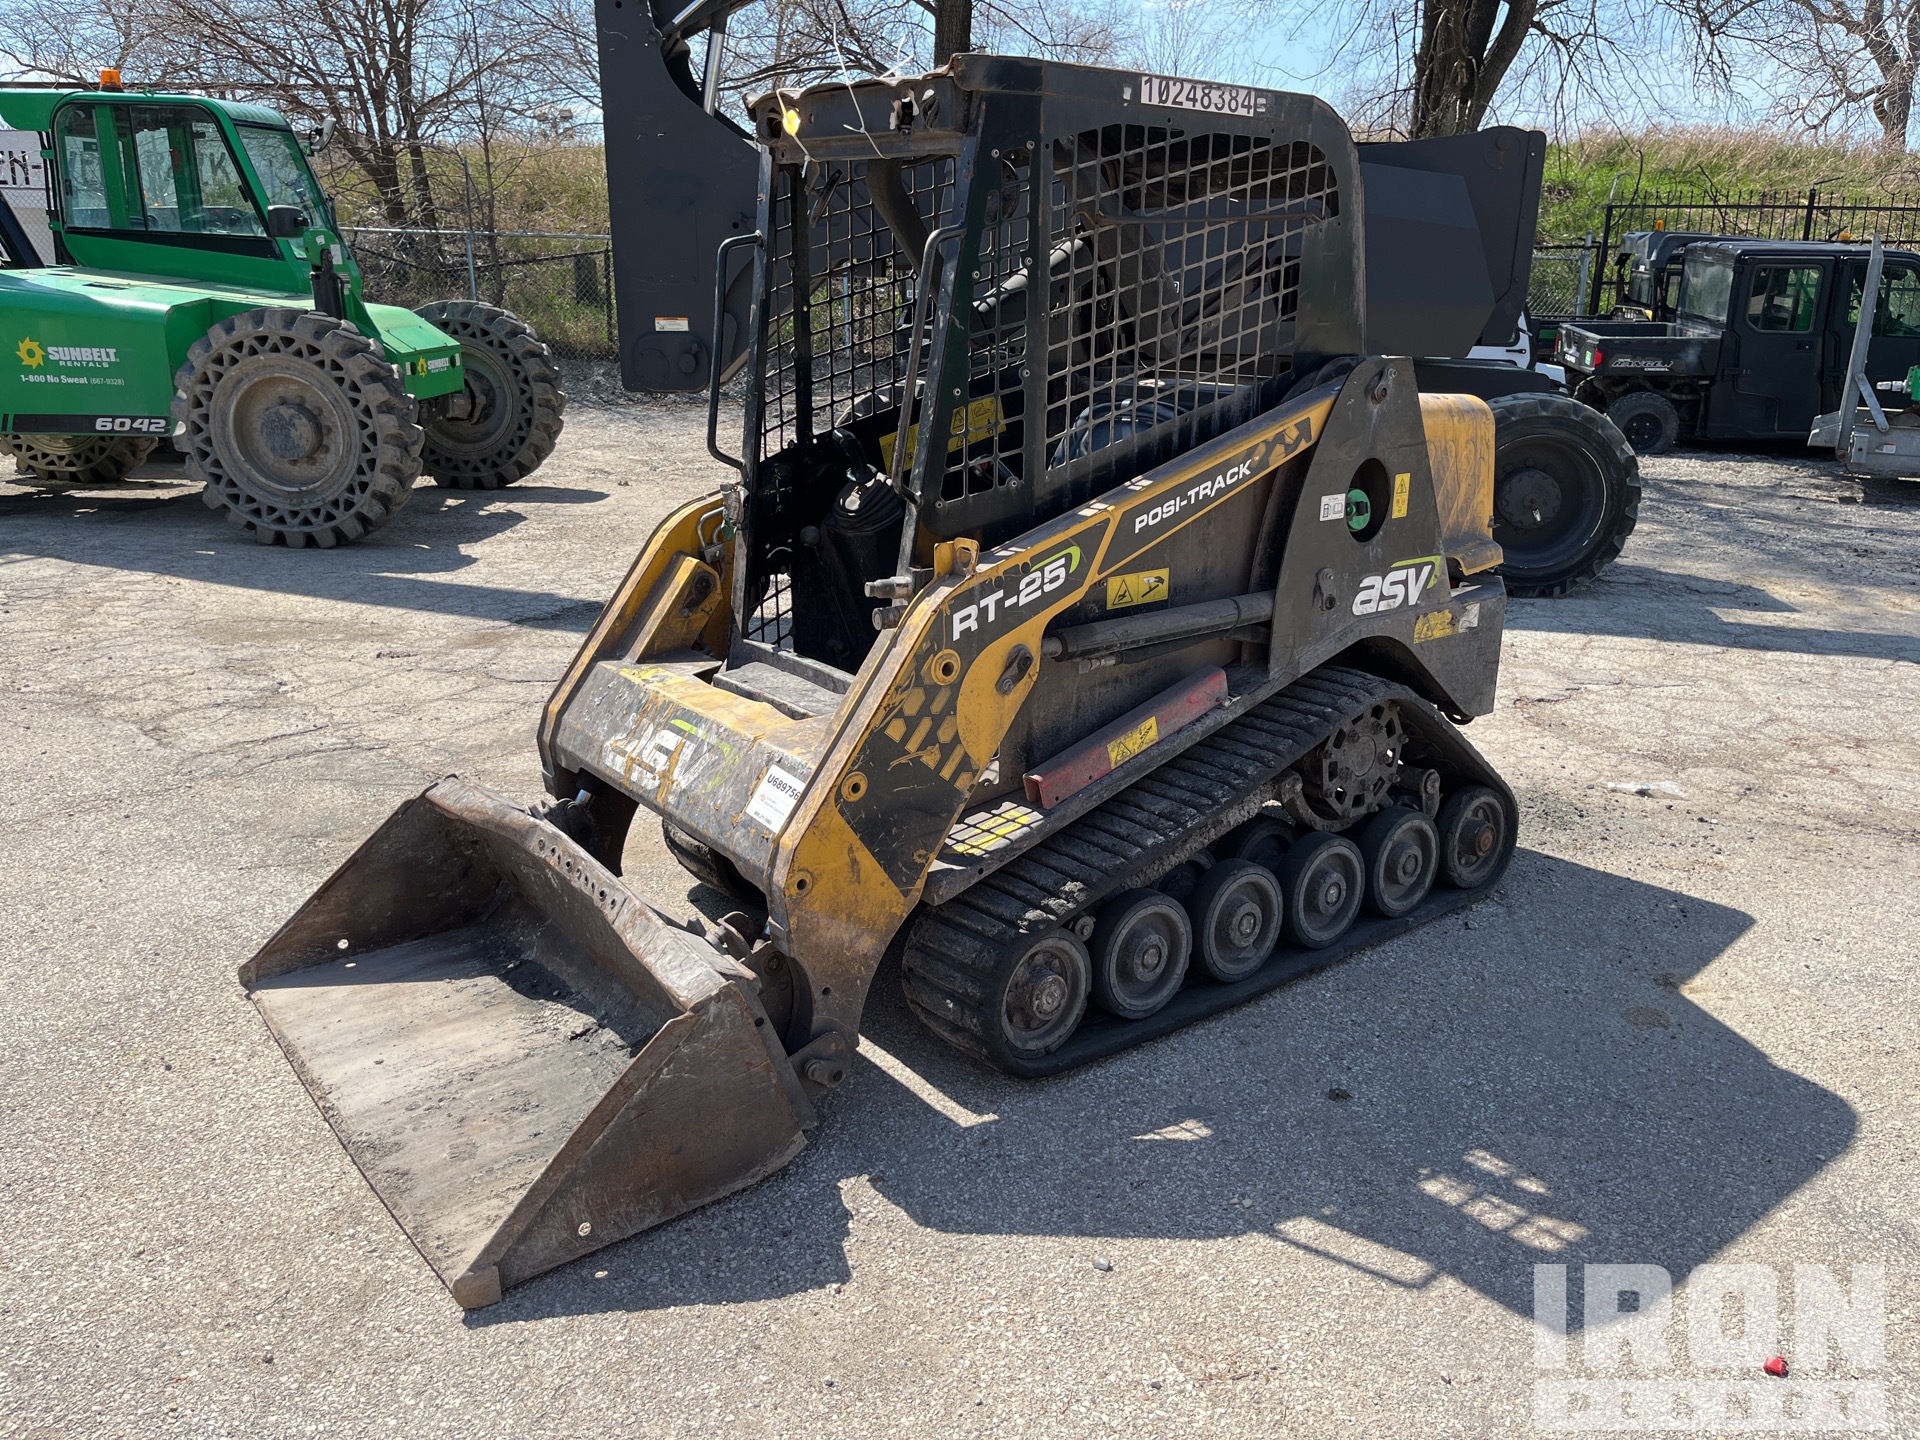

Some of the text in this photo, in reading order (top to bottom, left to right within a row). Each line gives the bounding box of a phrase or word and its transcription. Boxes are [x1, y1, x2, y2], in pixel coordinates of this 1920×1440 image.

[1143, 77, 1253, 115] 10248384
[47, 346, 118, 363] SUNBELT
[59, 360, 110, 368] RENTALS
[427, 357, 449, 370] SUNBELT
[20, 374, 125, 386] 1-800 No Sweat (667-9328)
[95, 417, 167, 432] 6042
[1134, 459, 1253, 534] POSI-TRACK
[952, 556, 1067, 642] RT-25
[767, 773, 801, 801] U689756
